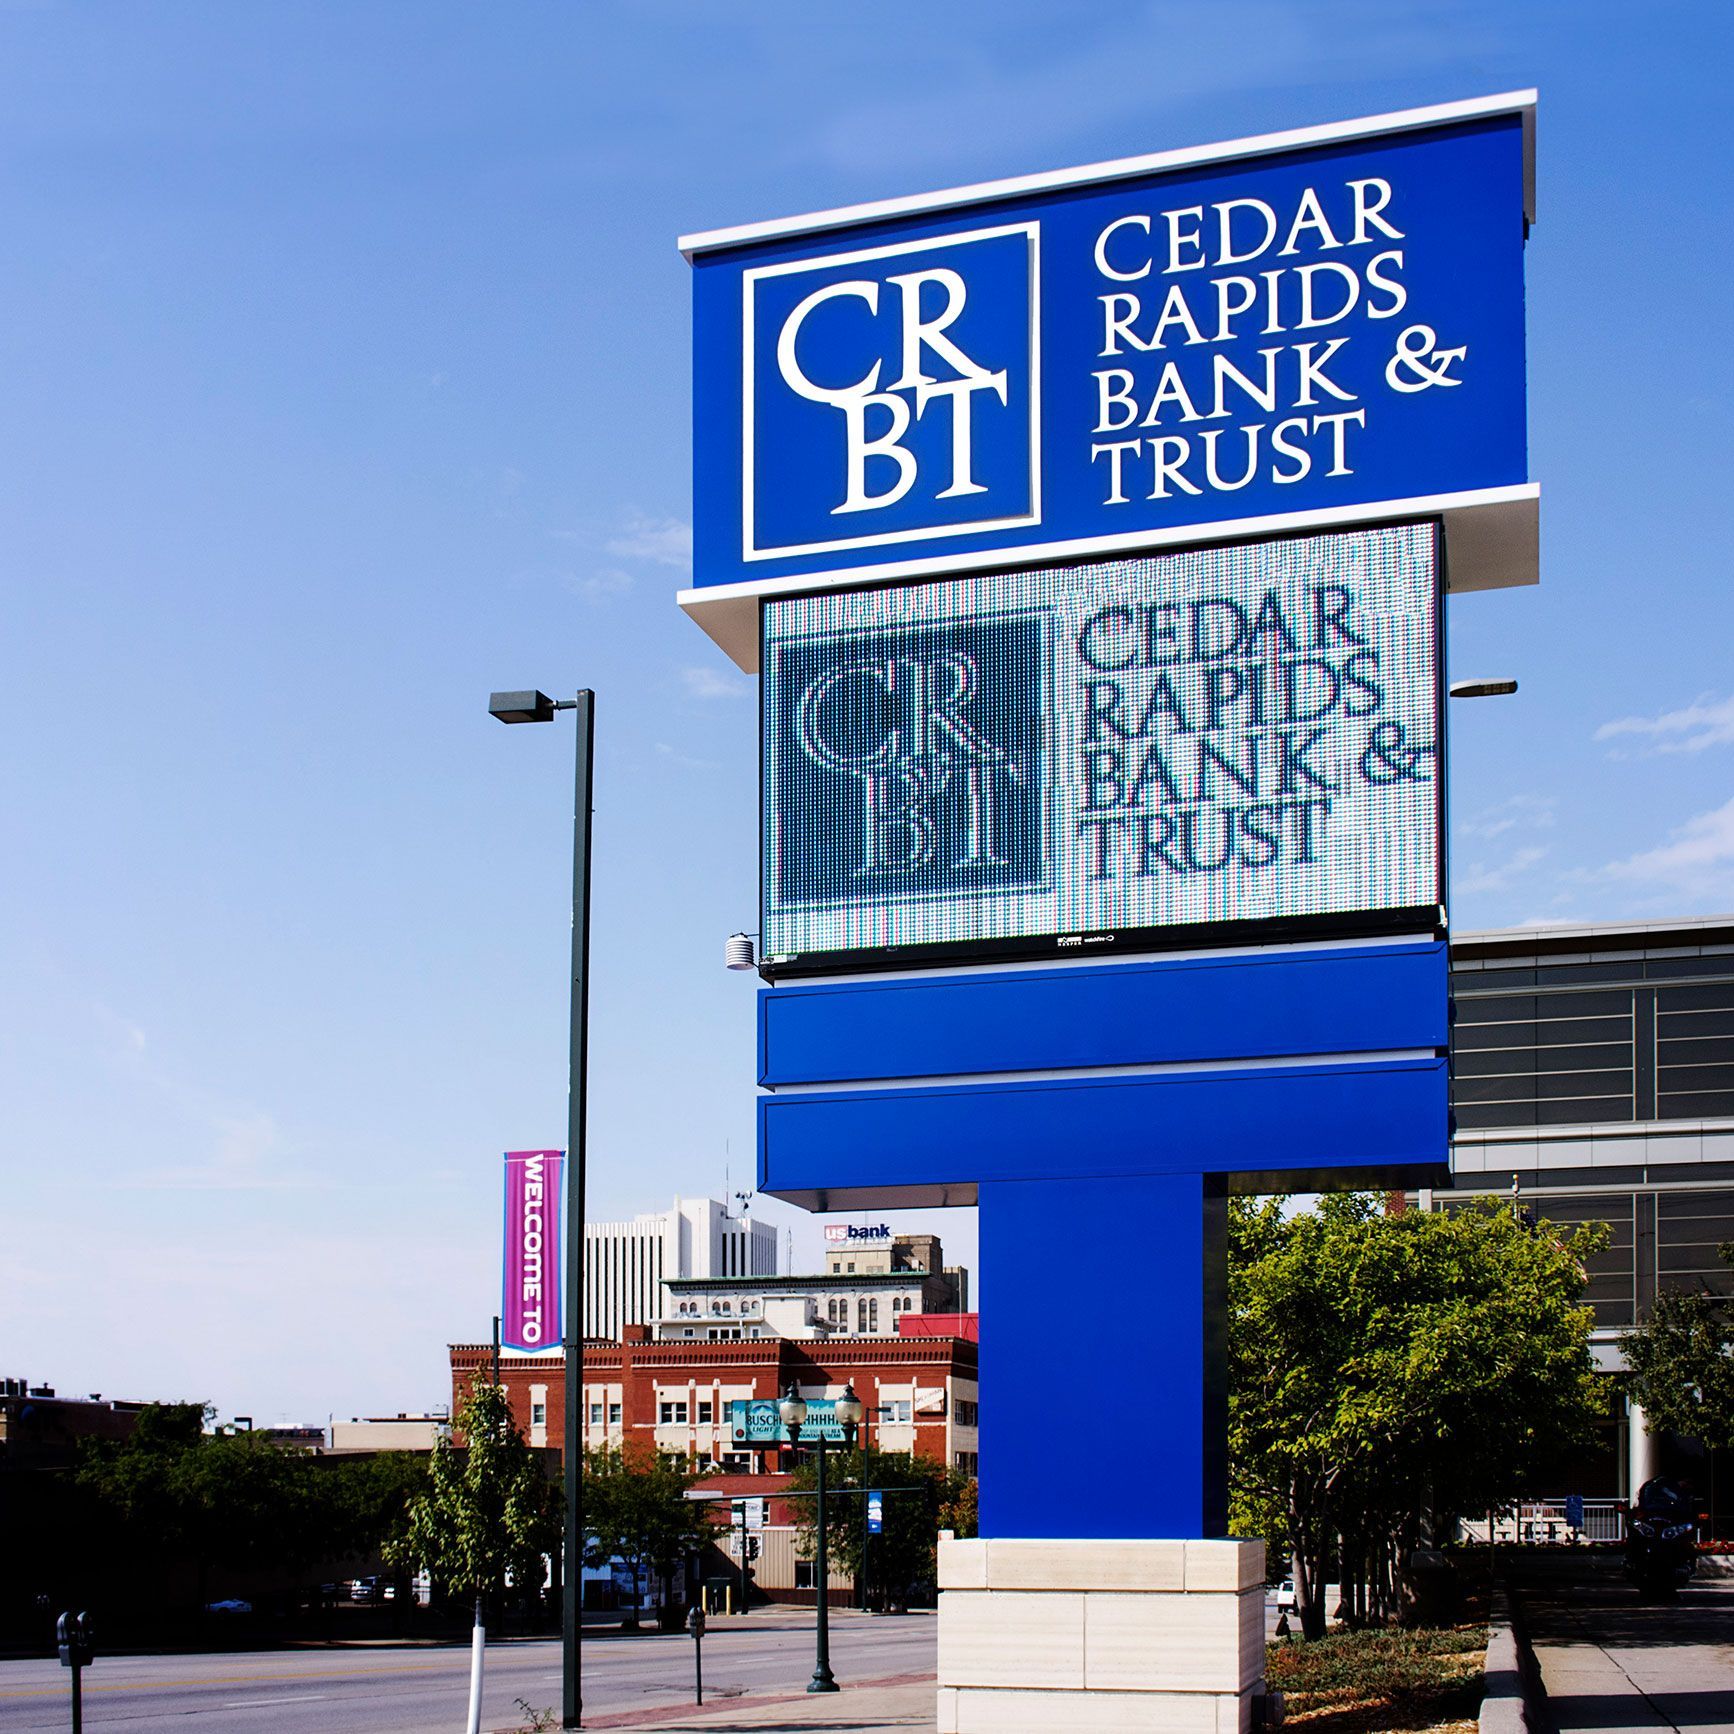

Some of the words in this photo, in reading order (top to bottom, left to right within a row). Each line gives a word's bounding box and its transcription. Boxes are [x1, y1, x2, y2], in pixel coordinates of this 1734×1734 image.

[1094, 178, 1406, 281] CEDAR
[1096, 250, 1408, 357] RAPIDS
[1091, 337, 1359, 433] BANK
[1384, 324, 1468, 393] &
[1091, 408, 1366, 505] TRUST
[1078, 583, 1367, 672] CEDAR
[1082, 650, 1385, 744] RAPIDS
[1081, 726, 1340, 813] BANK
[1357, 720, 1436, 787] &
[1077, 799, 1333, 881] TRUST
[523, 1153, 544, 1301] WELCOME
[522, 1305, 542, 1343] TO
